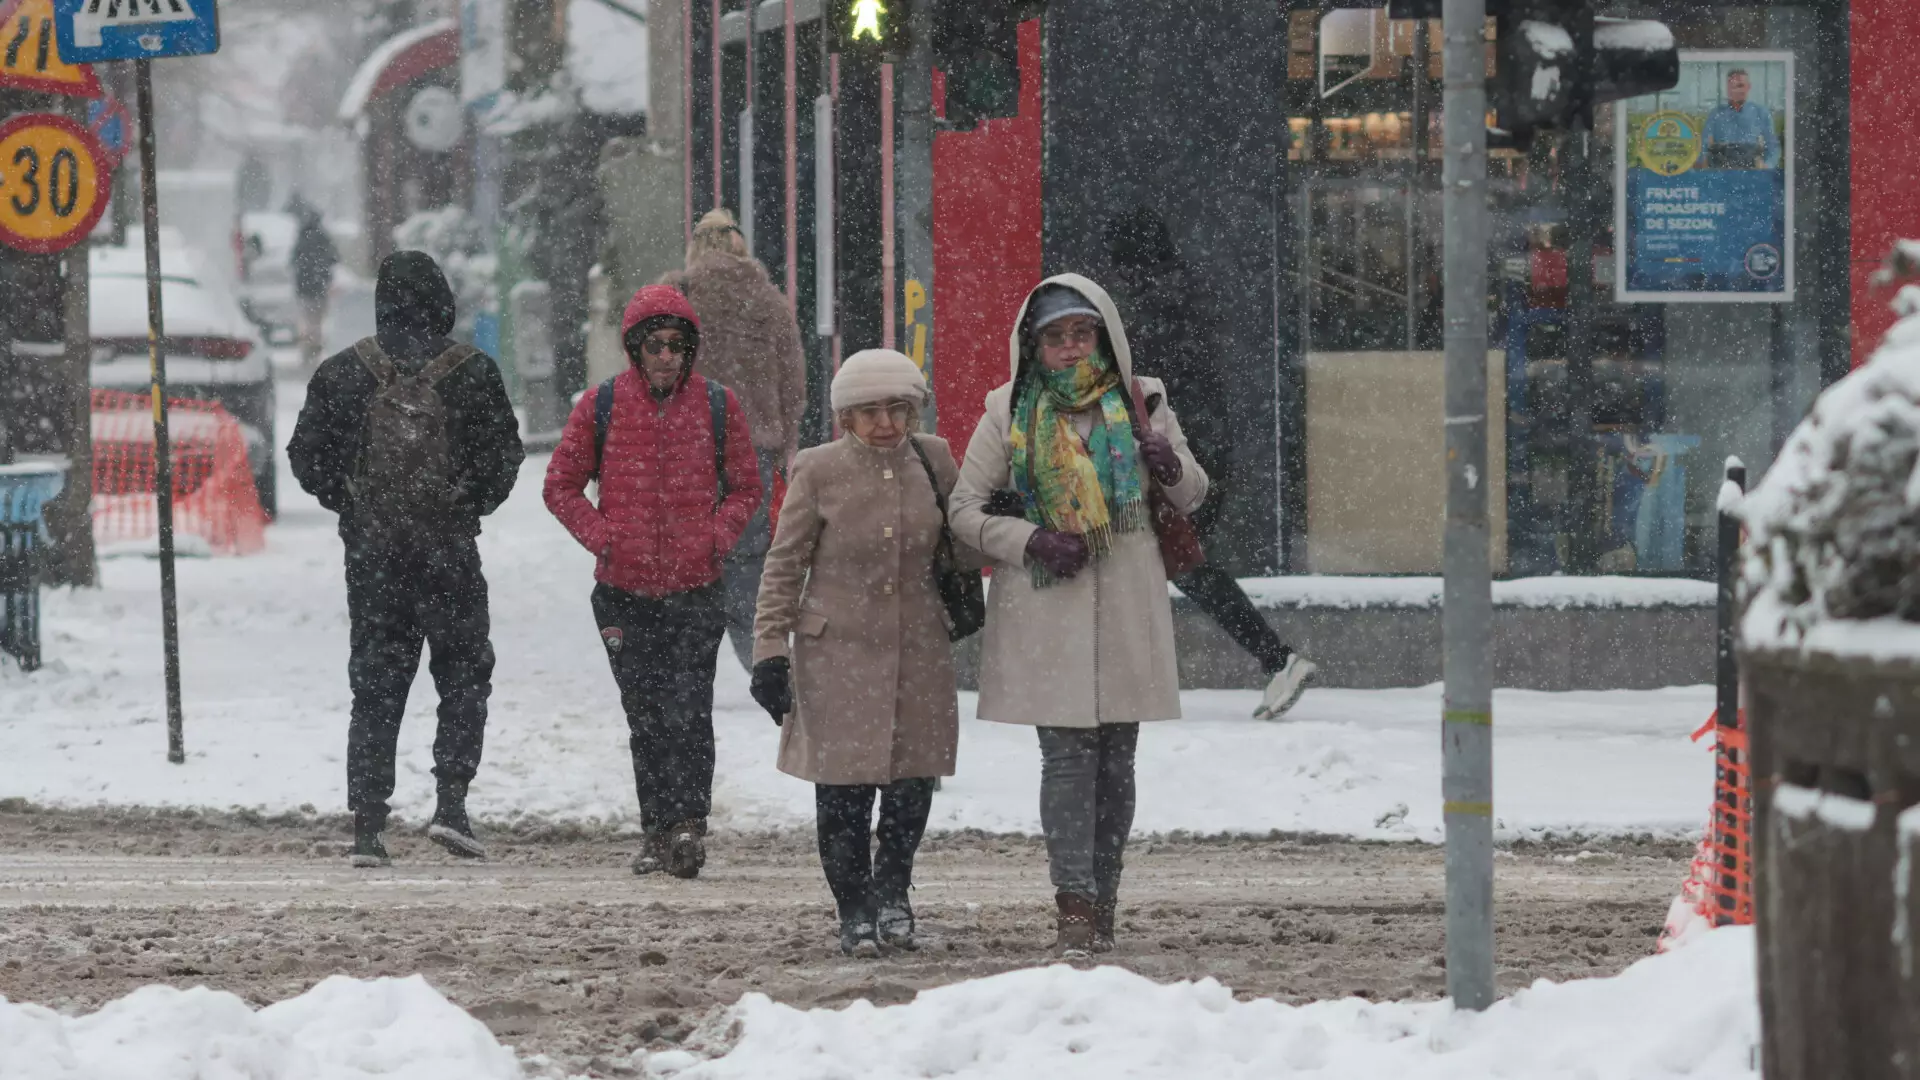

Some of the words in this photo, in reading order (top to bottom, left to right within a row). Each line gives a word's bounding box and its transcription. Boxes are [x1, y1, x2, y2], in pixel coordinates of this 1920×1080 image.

[11, 146, 78, 217] 30
[1646, 187, 1699, 199] FRUCTE
[1646, 203, 1725, 215] PROASPETE
[1646, 218, 1664, 230] DE
